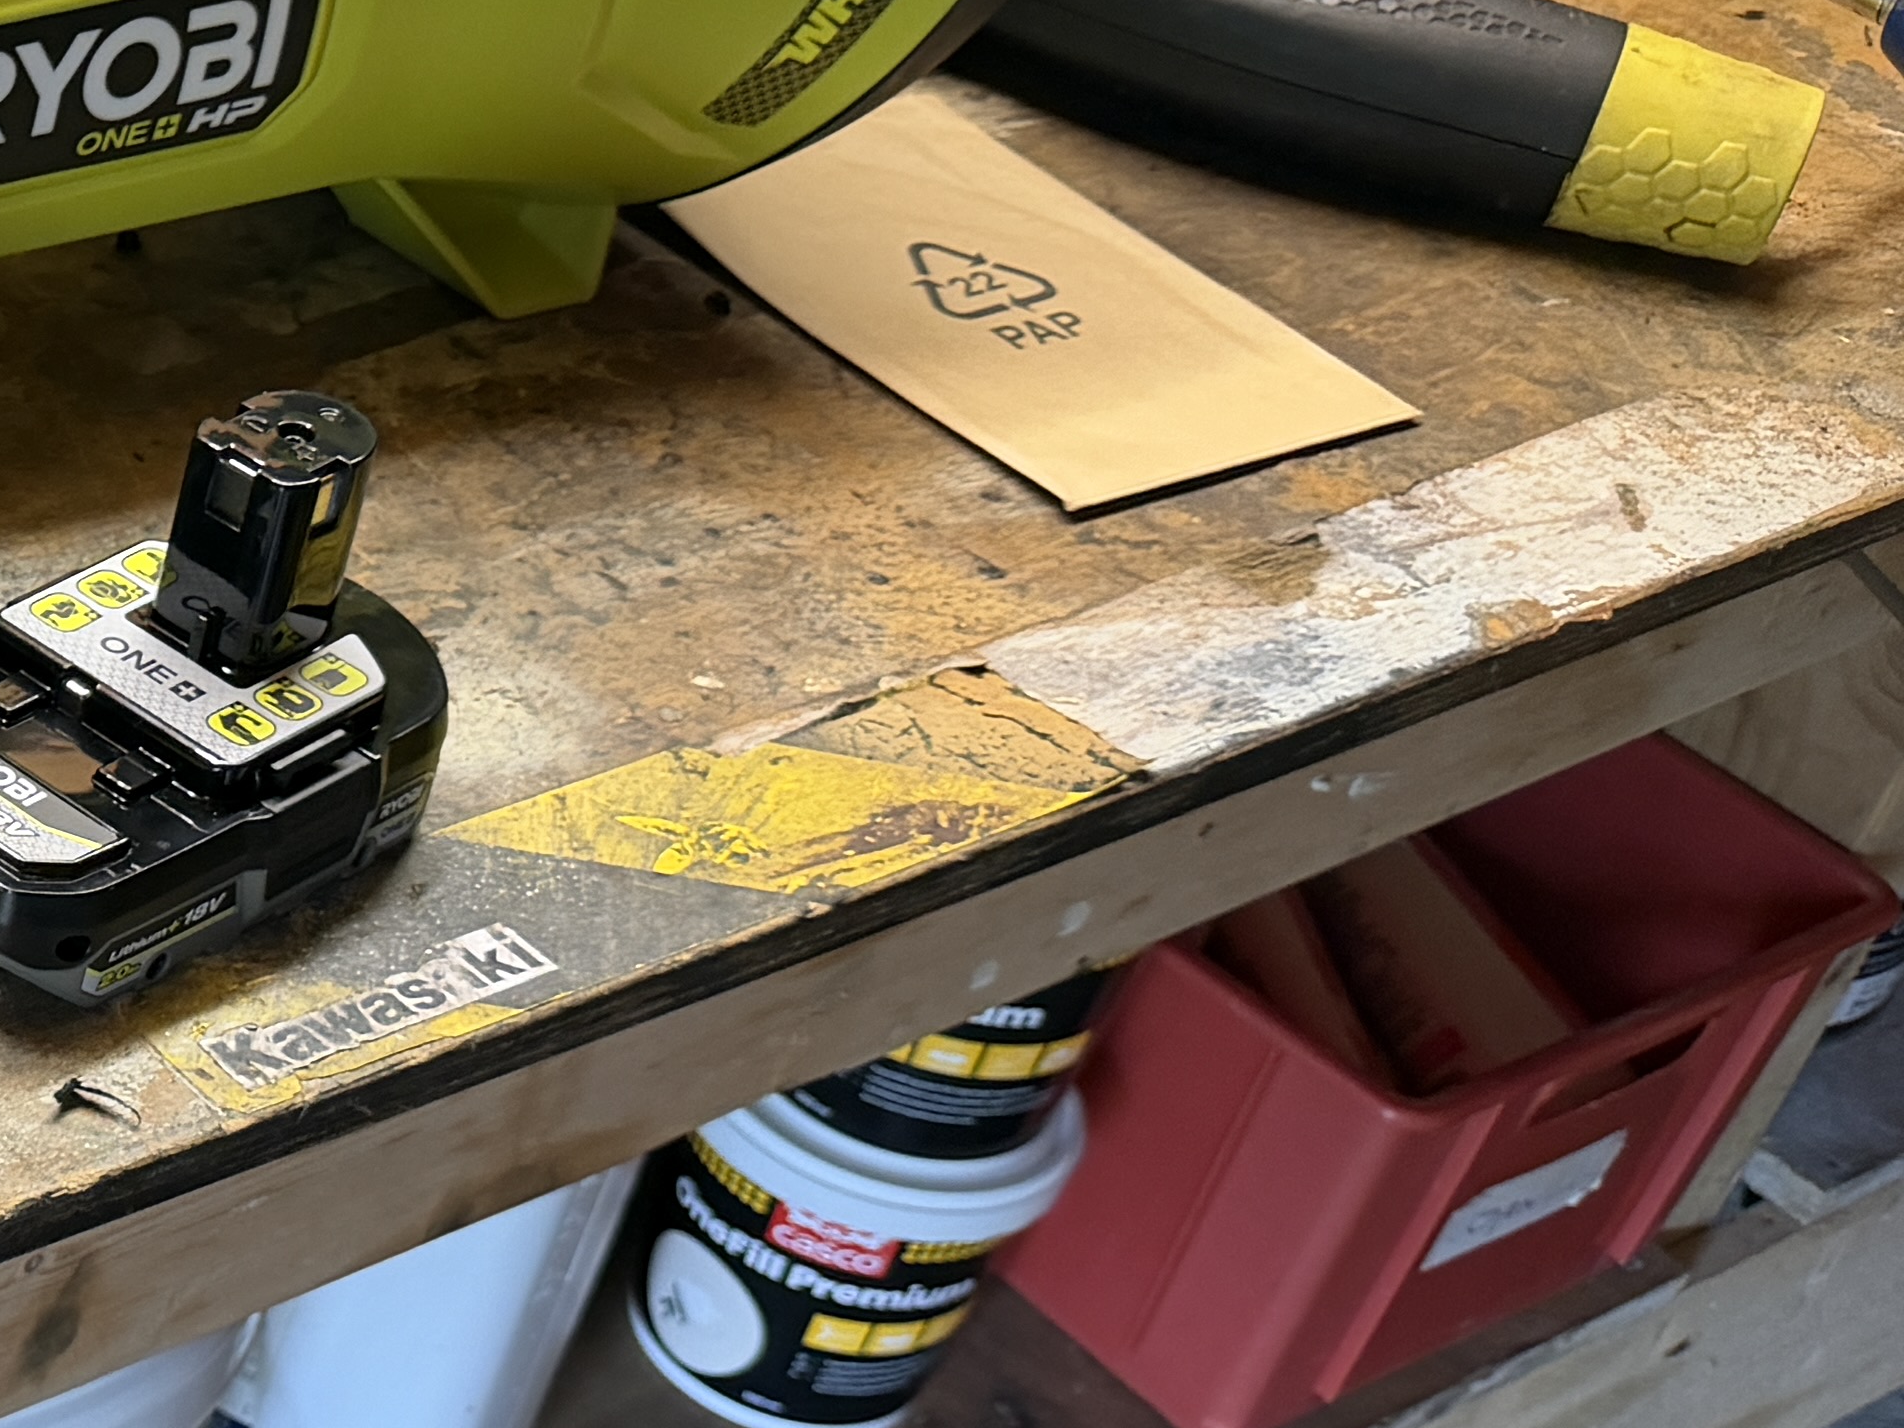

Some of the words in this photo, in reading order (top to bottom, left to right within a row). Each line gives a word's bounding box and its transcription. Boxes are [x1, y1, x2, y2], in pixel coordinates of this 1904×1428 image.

[186, 95, 268, 134] HP
[948, 270, 1007, 298] 22
[990, 310, 1083, 351] PAP
[183, 891, 228, 926] 18V
[784, 1262, 979, 1314] Premium
